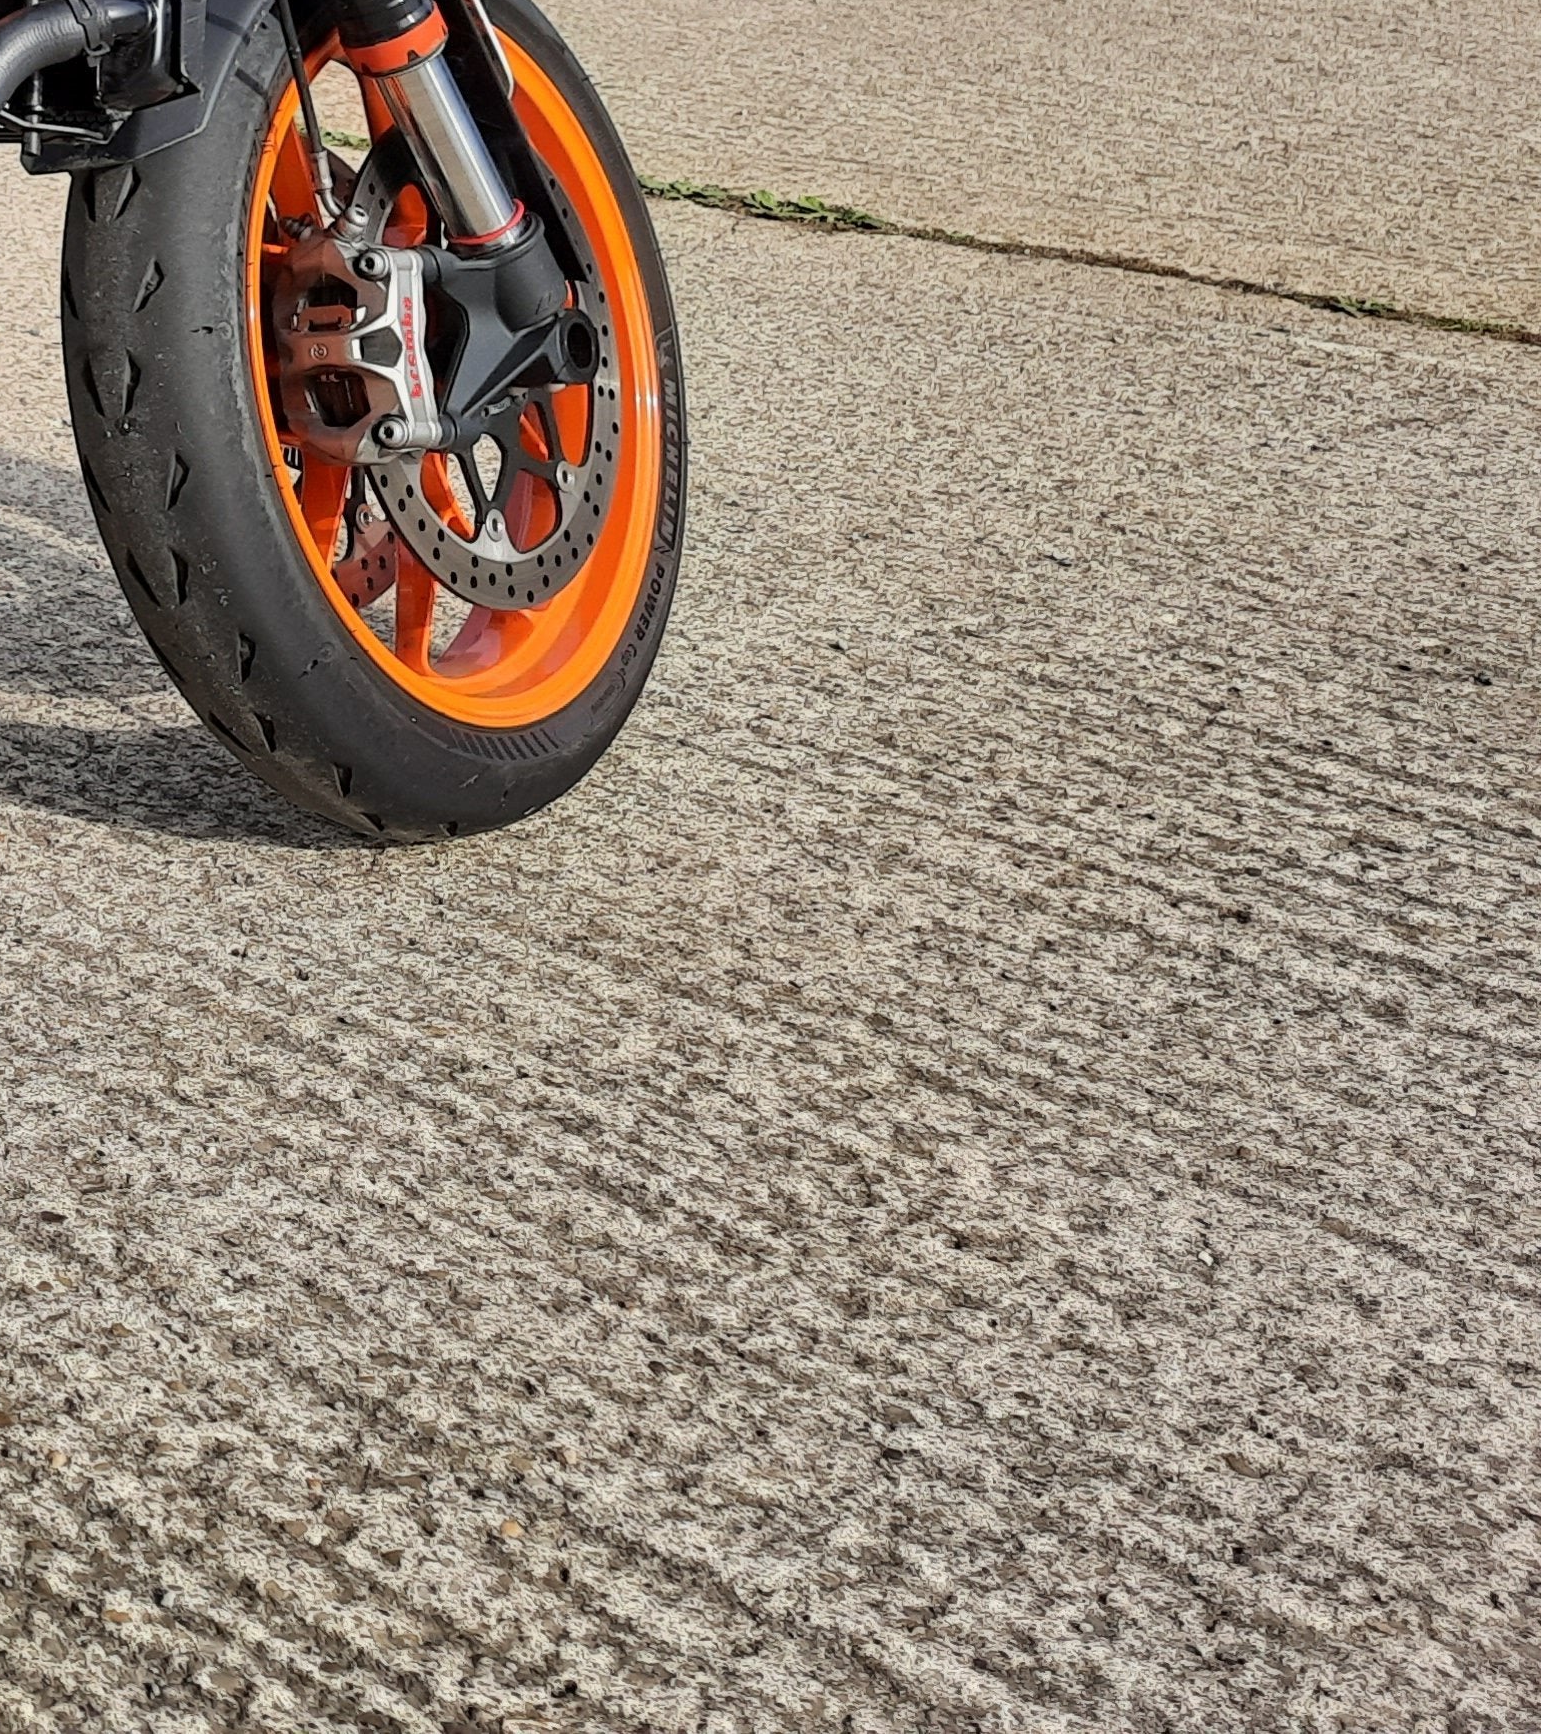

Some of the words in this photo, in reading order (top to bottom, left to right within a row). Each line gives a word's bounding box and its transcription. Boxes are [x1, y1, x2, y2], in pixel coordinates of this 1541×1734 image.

[400, 296, 424, 399] brembo
[661, 377, 681, 546] MICHELIN
[634, 562, 666, 641] POWER
